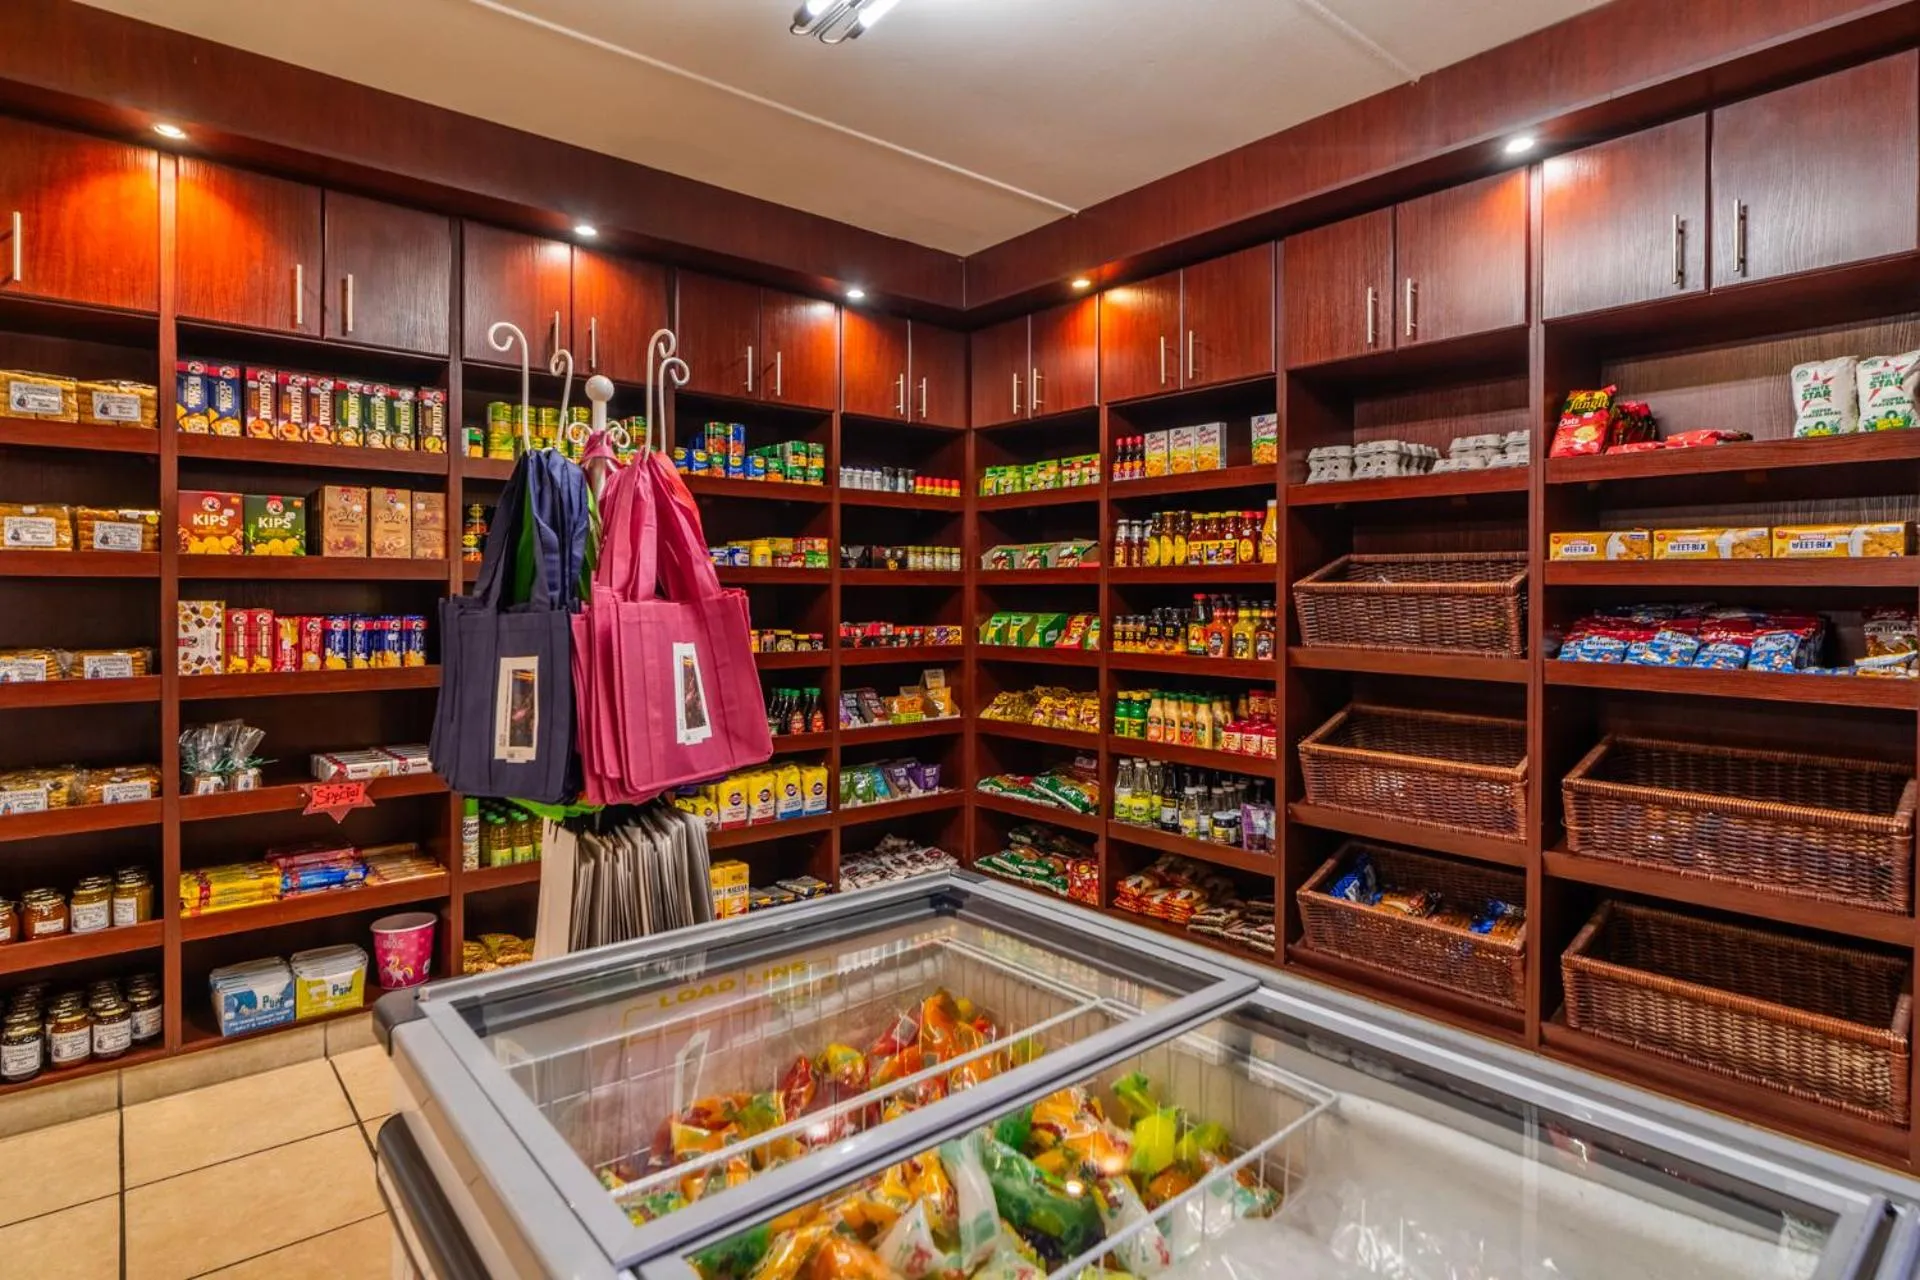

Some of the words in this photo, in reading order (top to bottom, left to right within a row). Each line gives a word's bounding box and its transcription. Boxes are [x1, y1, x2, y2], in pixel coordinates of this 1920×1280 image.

[1870, 379, 1903, 389] STAR
[1802, 390, 1832, 400] STAR
[1568, 397, 1610, 412] Jungle
[1560, 418, 1579, 427] Oats
[193, 514, 229, 527] KIPS
[258, 517, 292, 529] KIPS
[316, 788, 360, 805] Special
[659, 976, 737, 1008] LOAD
[747, 960, 807, 984] LINE
